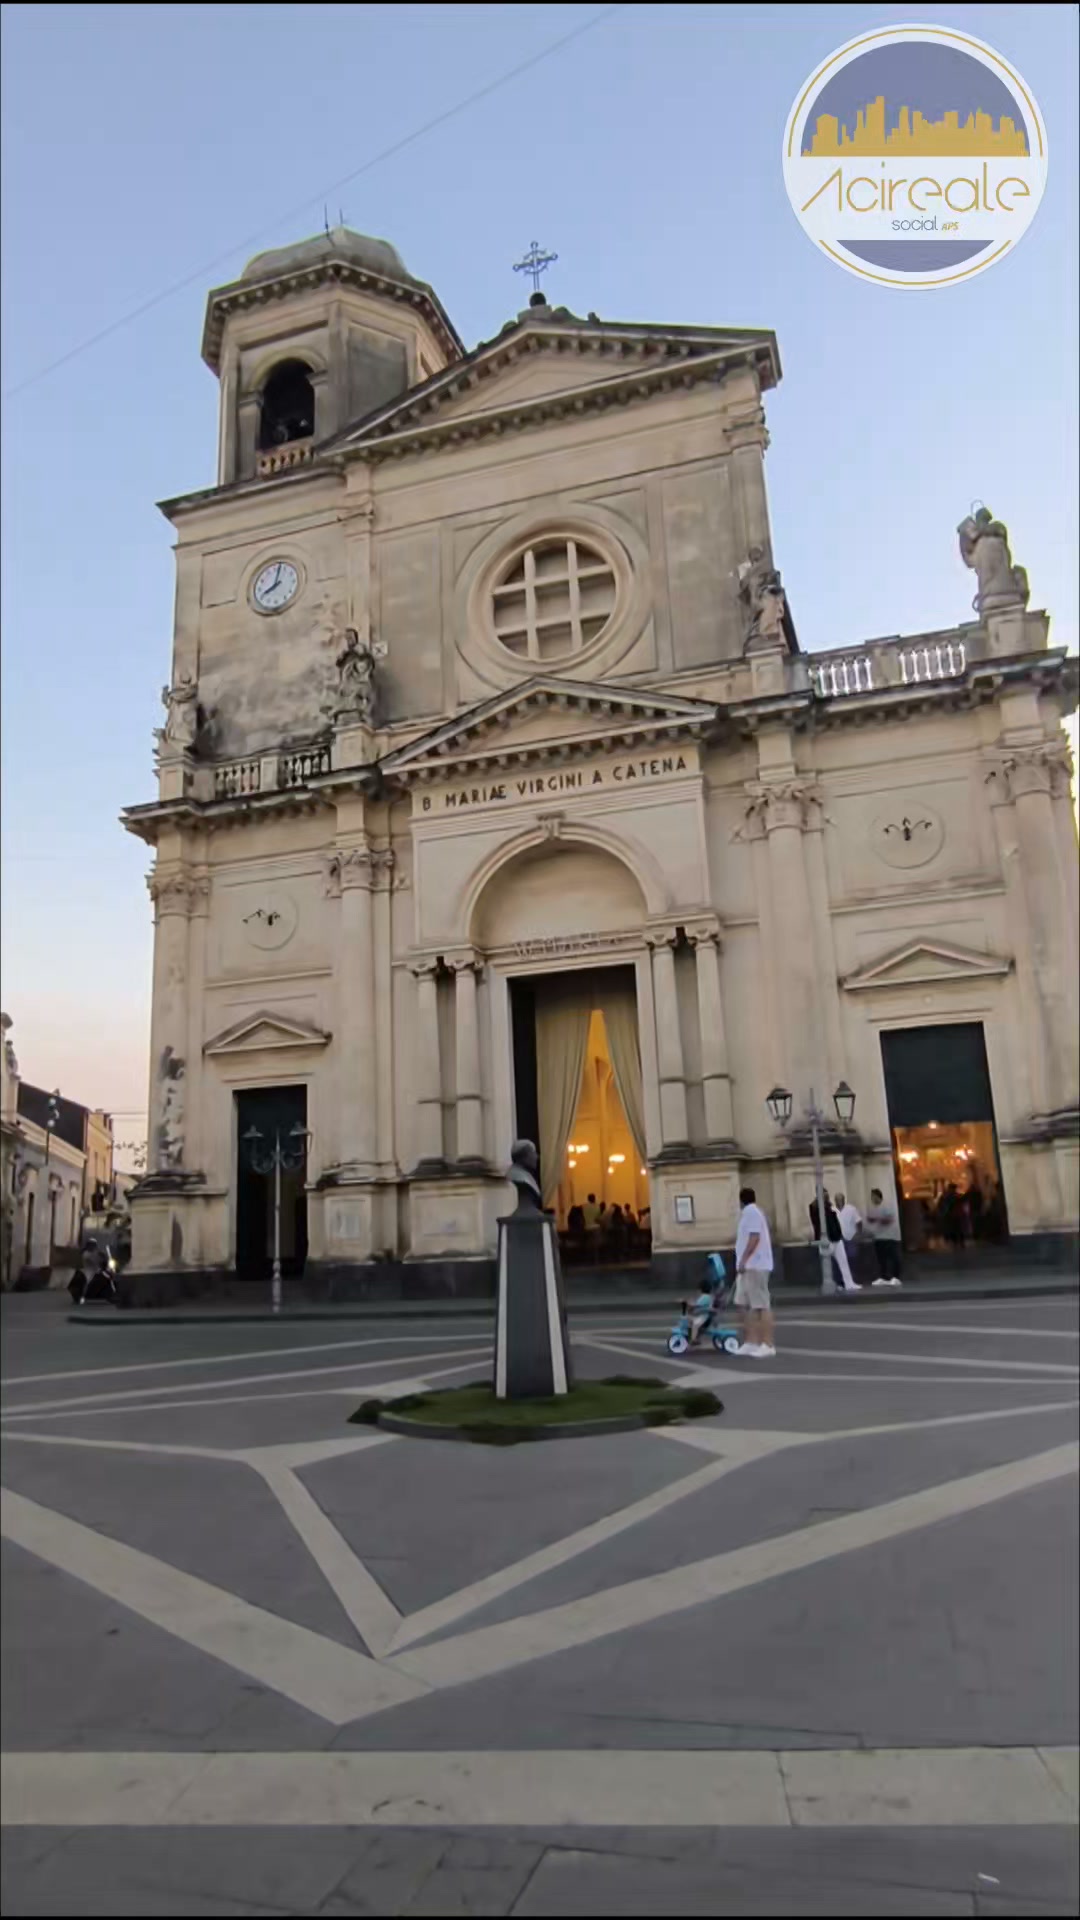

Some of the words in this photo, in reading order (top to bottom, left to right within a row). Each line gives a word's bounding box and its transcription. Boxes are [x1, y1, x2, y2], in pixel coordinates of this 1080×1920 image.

[517, 771, 582, 796] VIRGINI
[592, 769, 603, 785] A
[612, 756, 687, 781] CATENA
